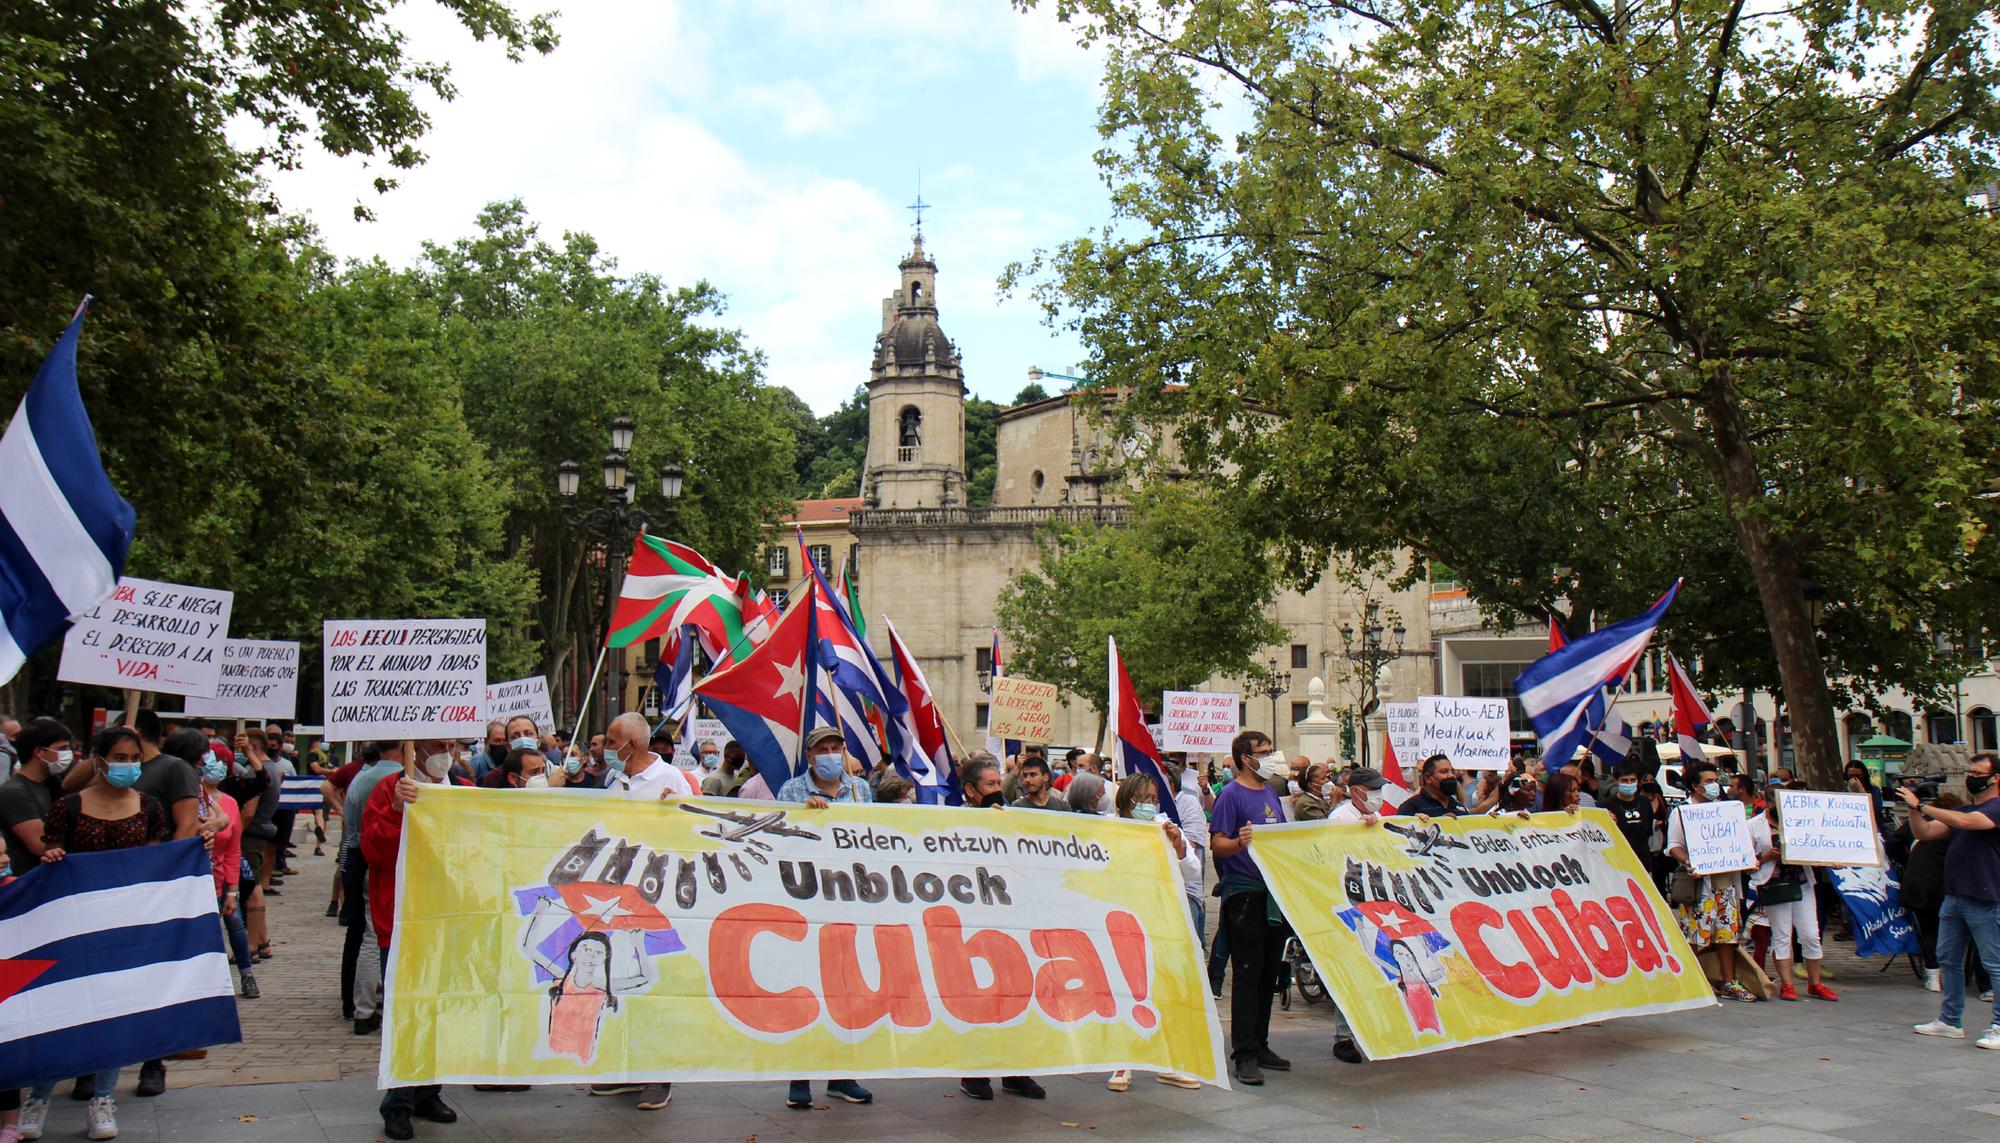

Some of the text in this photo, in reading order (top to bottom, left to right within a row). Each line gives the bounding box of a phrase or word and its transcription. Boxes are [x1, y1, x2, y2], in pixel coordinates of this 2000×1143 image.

[179, 596, 222, 616] NIEGA
[112, 608, 200, 636] DESARROLLO
[207, 623, 219, 639] Y
[82, 630, 212, 663] EL DERECHO A LA
[331, 629, 357, 647] LOS
[409, 628, 486, 646] PERSIGUEN
[256, 647, 295, 661] PUEBLO
[330, 654, 480, 672] POR EL MUNDO TODAS
[277, 667, 297, 679] QUE
[331, 679, 472, 697] LAS TRANSACCIONES
[533, 681, 543, 693] LA
[1013, 682, 1055, 698] RESPETO
[1006, 696, 1043, 712] DERECHO
[1434, 700, 1505, 720] Kuba-AEB
[331, 705, 420, 723] COMERCIALES
[421, 705, 441, 722] DE
[1016, 712, 1050, 725] AJENO
[995, 722, 1011, 735] ES
[1014, 725, 1027, 737] LA
[1785, 815, 1815, 828] ezin
[832, 826, 1109, 863] Biden, entzun mundua:
[1469, 833, 1520, 855] Biden,
[1729, 839, 1742, 853] du
[1450, 877, 1681, 999] Cuba!
[708, 902, 1157, 1034] Cuba!
